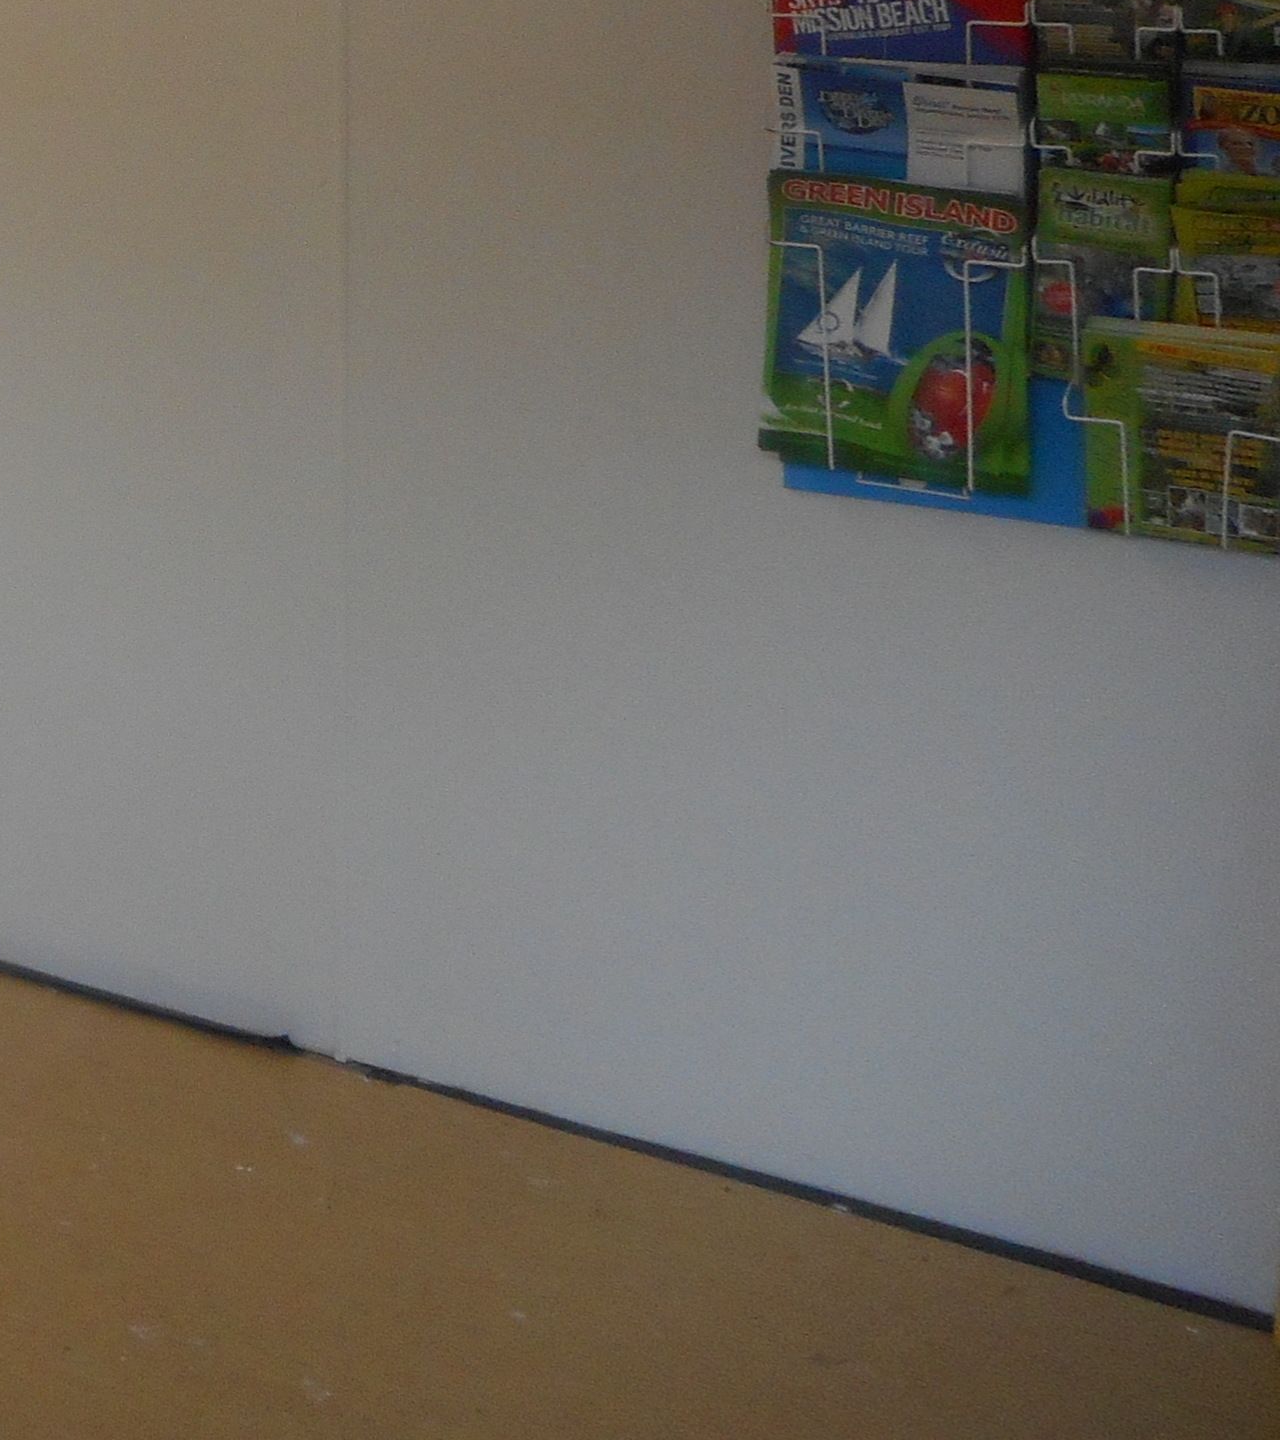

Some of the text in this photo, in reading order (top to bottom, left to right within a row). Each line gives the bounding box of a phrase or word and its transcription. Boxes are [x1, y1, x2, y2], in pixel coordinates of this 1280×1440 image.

[793, 2, 874, 35] MISSION
[777, 71, 795, 108] DEN
[782, 178, 1019, 234] GREEN ISLAND
